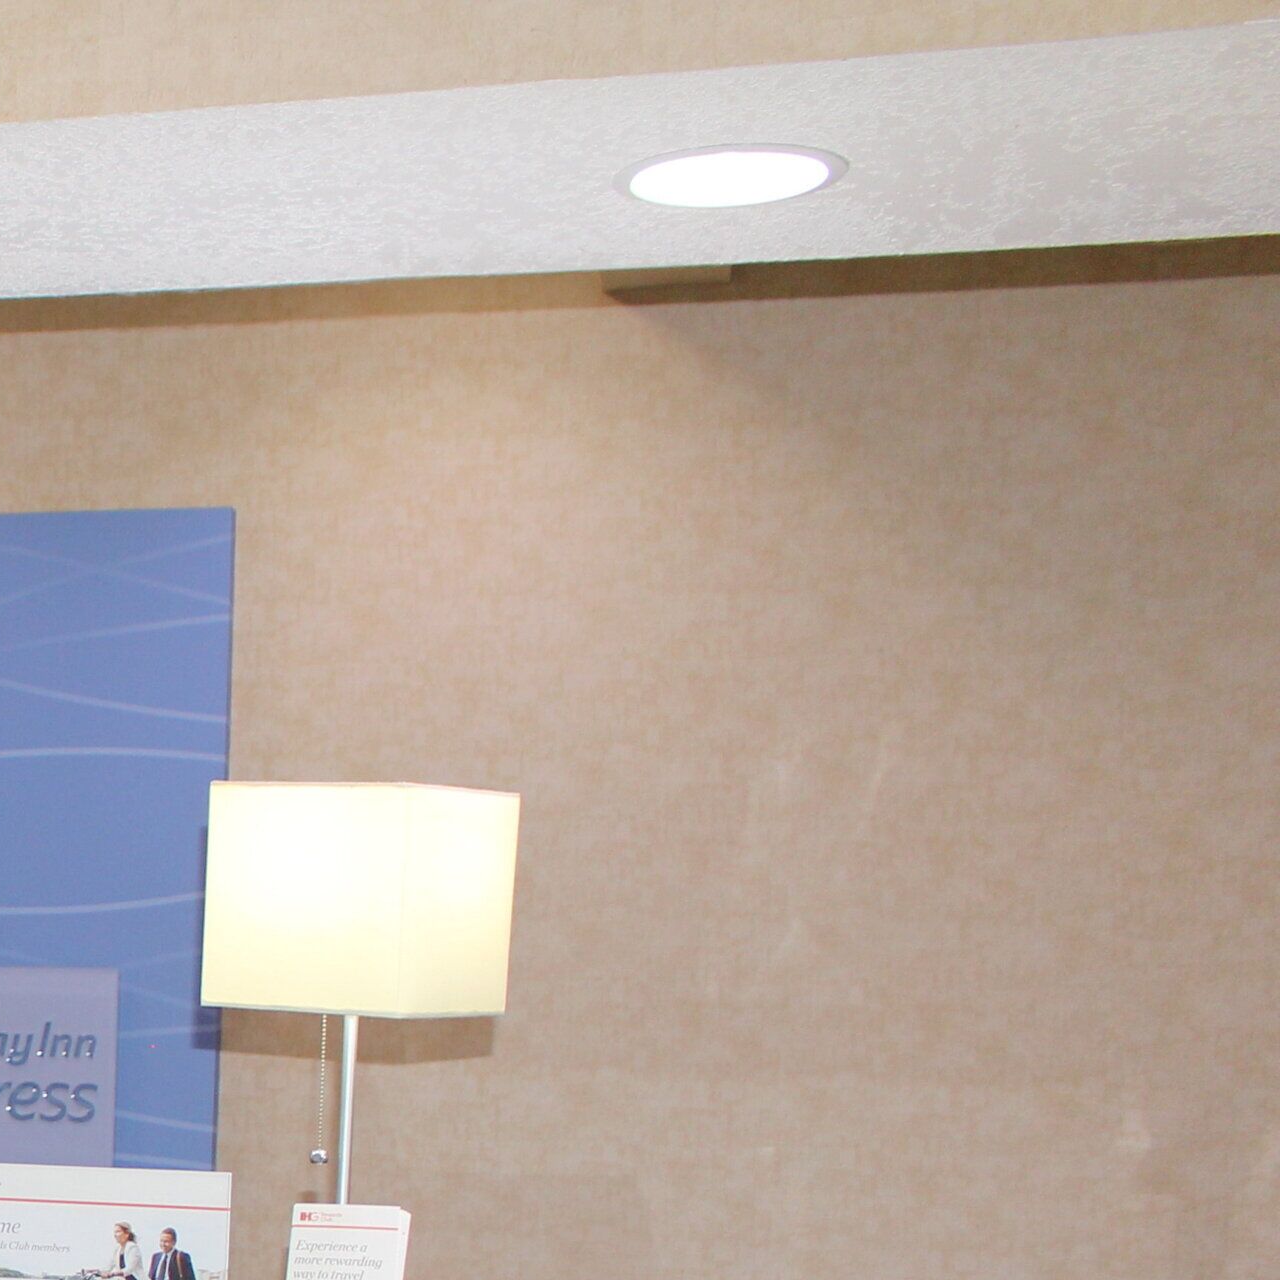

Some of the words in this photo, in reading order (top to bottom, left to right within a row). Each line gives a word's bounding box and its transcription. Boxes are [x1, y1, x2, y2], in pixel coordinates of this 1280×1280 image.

[35, 1022, 97, 1058] Inn
[8, 1240, 31, 1251] Club
[30, 1242, 71, 1253] members
[295, 1240, 355, 1254] Experience
[359, 1244, 368, 1253] a
[294, 1256, 323, 1265] more
[323, 1256, 383, 1270] rewarding
[293, 1270, 316, 1280] way
[317, 1270, 328, 1279] to
[330, 1270, 365, 1280] travel
